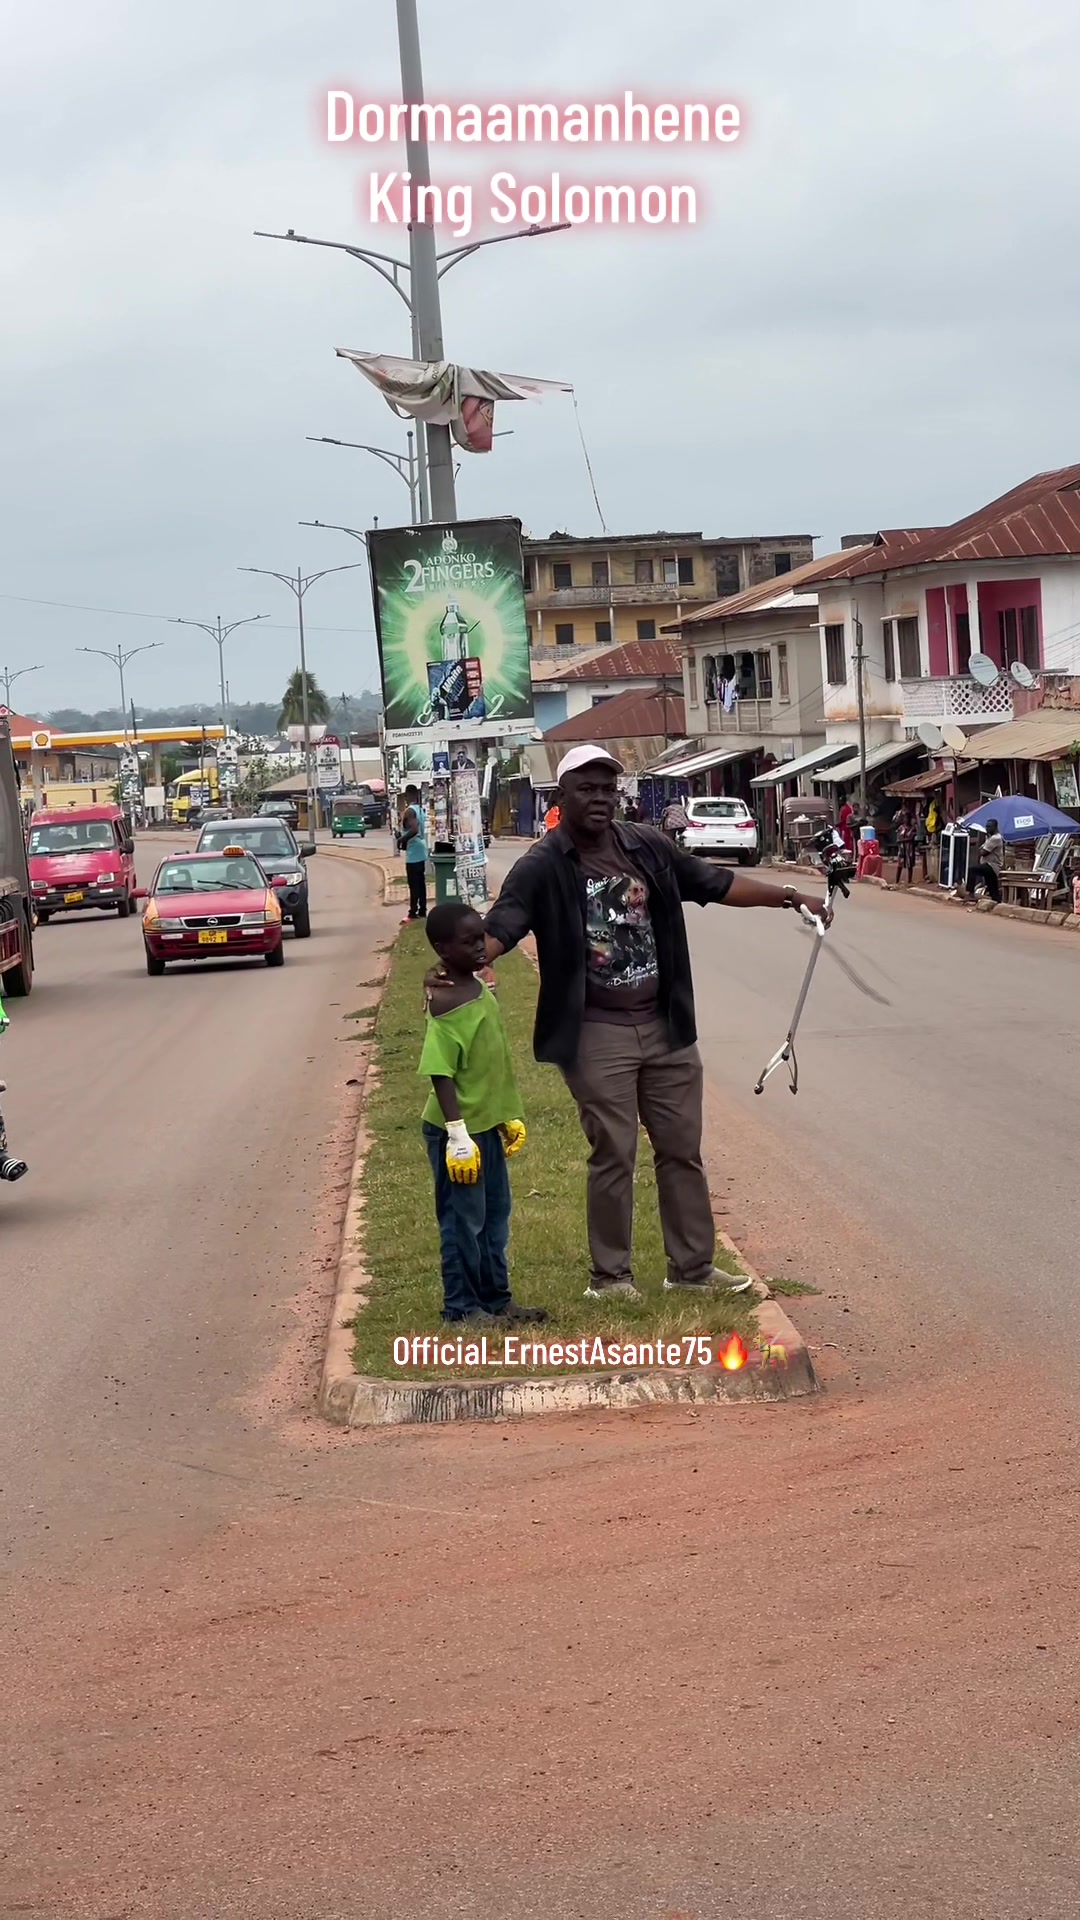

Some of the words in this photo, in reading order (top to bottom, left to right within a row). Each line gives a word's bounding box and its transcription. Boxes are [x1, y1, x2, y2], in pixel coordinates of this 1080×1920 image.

[426, 553, 476, 566] ADONKO
[403, 559, 426, 593] 2
[421, 561, 495, 583] FINGERS
[441, 665, 463, 693] White
